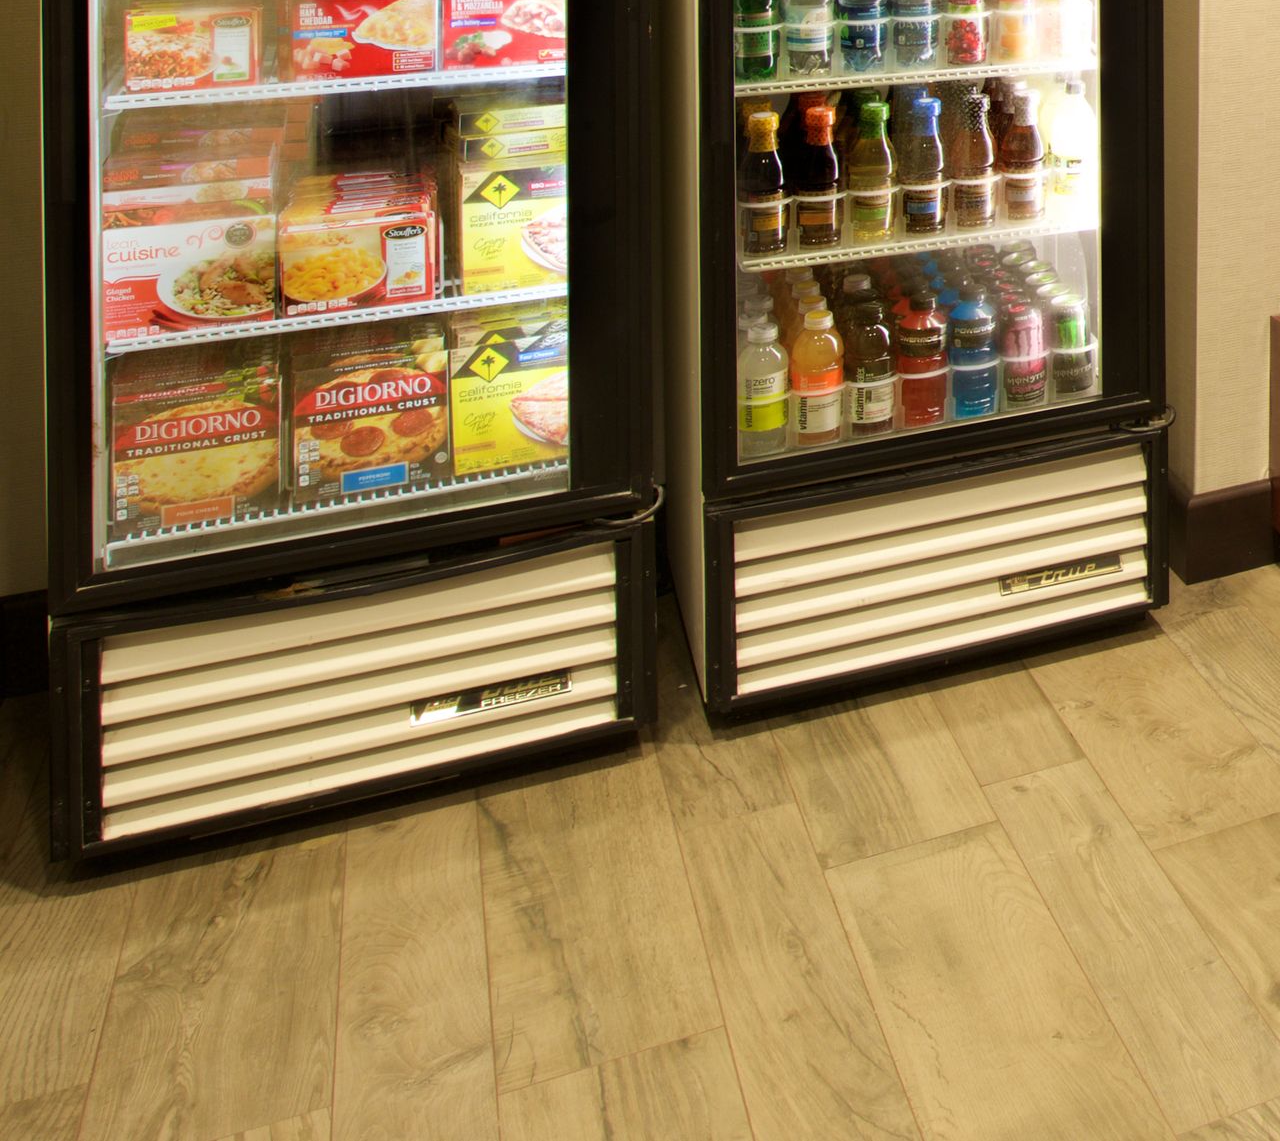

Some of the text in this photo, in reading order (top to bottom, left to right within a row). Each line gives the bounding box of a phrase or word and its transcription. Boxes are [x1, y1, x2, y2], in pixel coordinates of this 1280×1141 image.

[753, 376, 776, 387] zero
[307, 396, 437, 423] TRADITIONAL CRUST
[126, 430, 266, 458] TRADITIONAL CRUST
[480, 684, 561, 708] FREEZER
